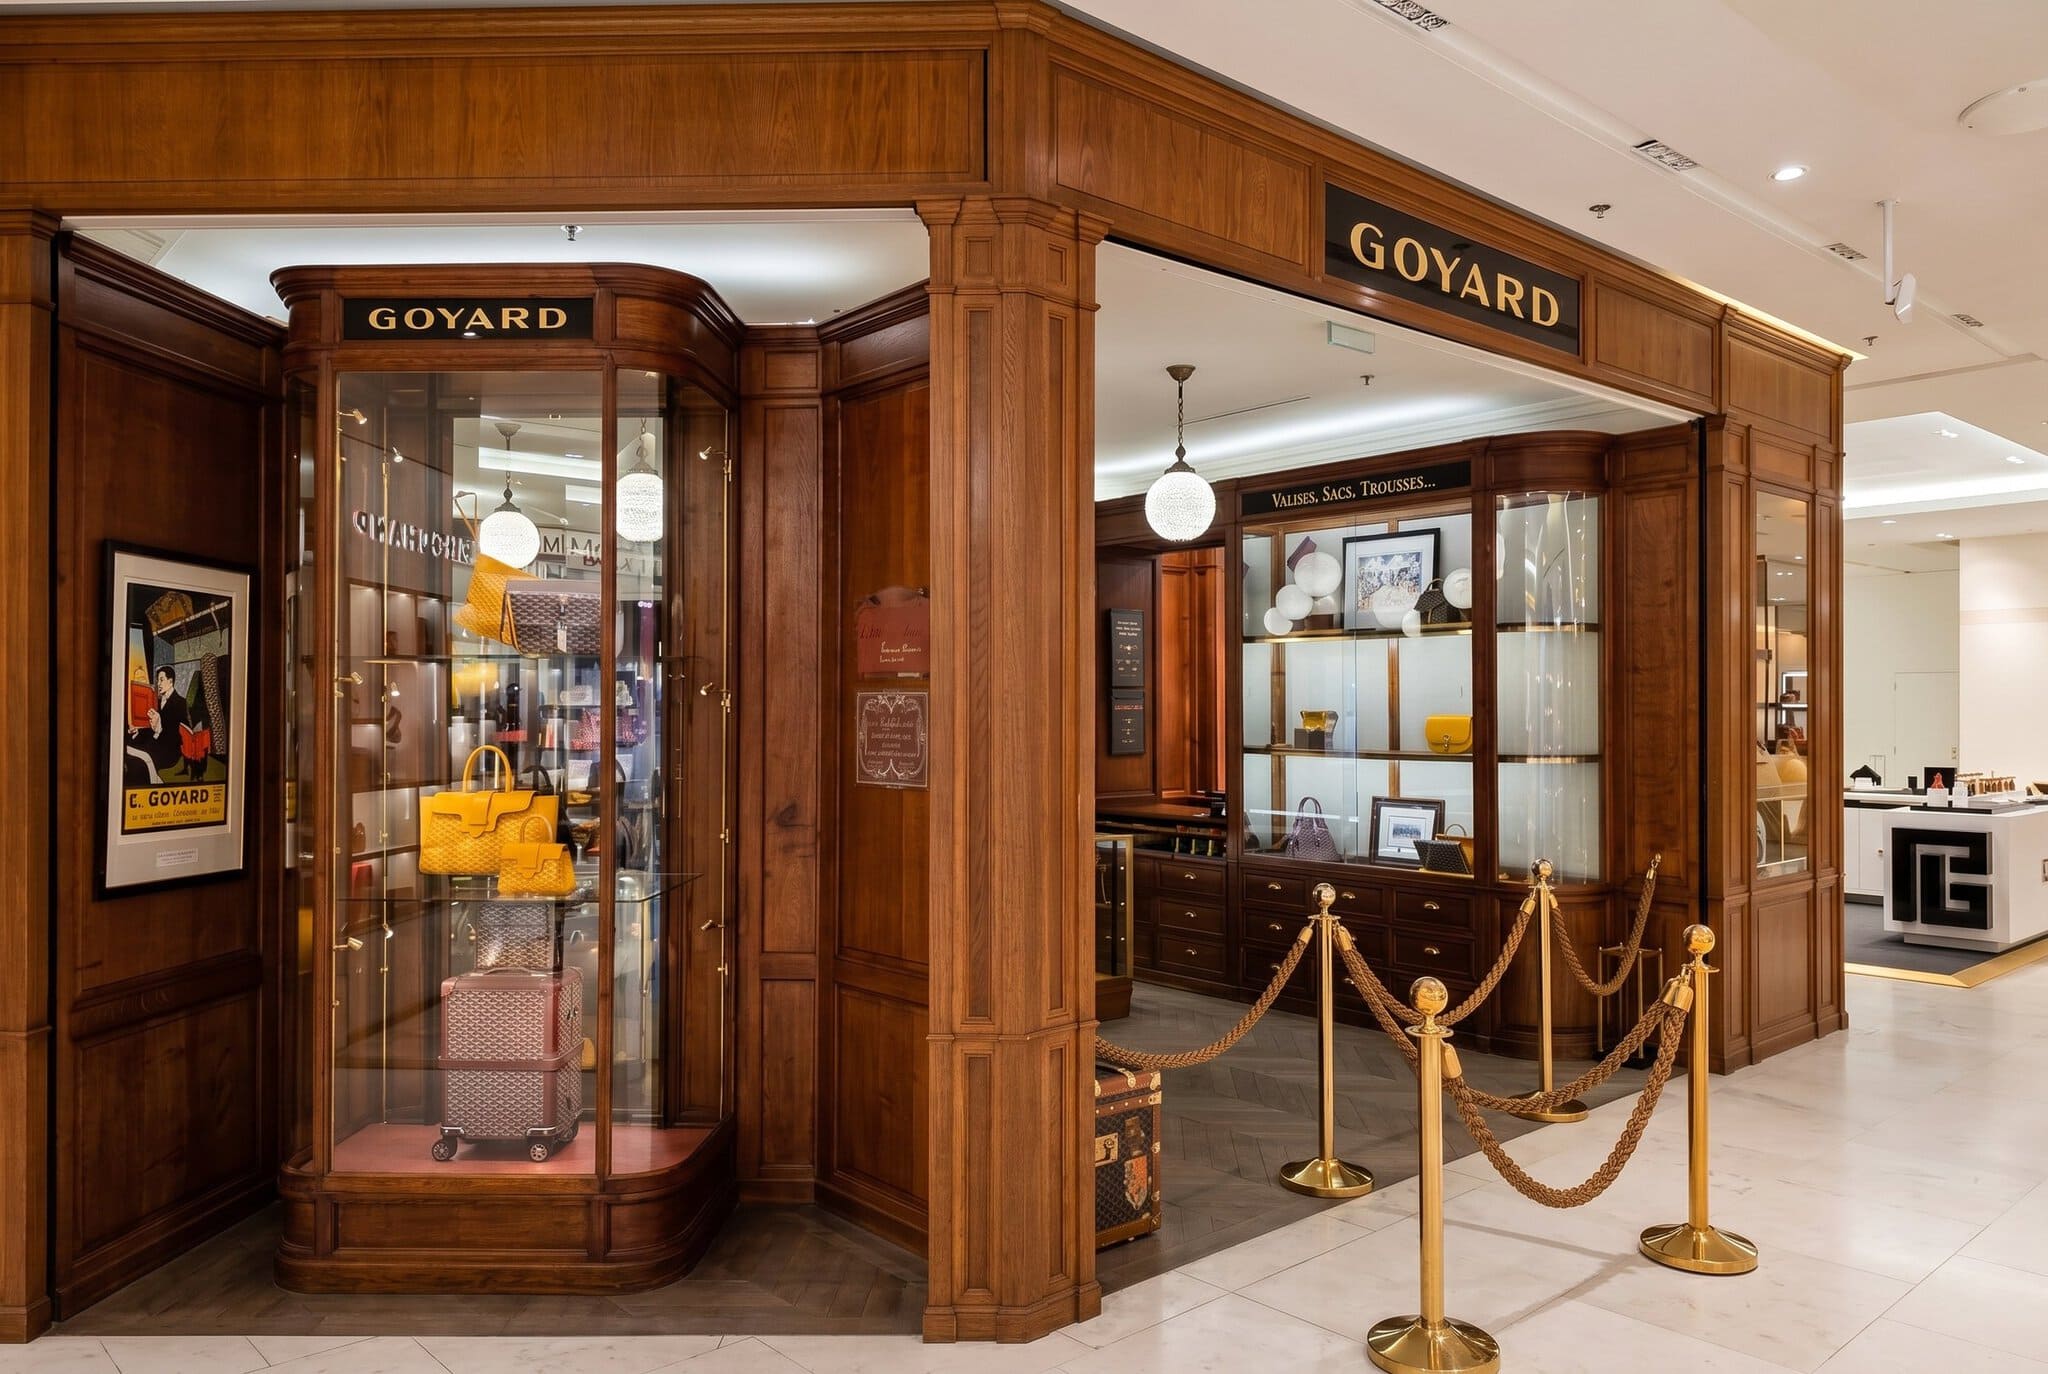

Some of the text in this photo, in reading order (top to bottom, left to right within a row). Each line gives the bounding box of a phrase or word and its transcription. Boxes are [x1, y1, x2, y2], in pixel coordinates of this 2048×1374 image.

[1351, 222, 1560, 327] GOYARD
[368, 306, 568, 330] GOYARD
[148, 788, 209, 807] GOYARD
